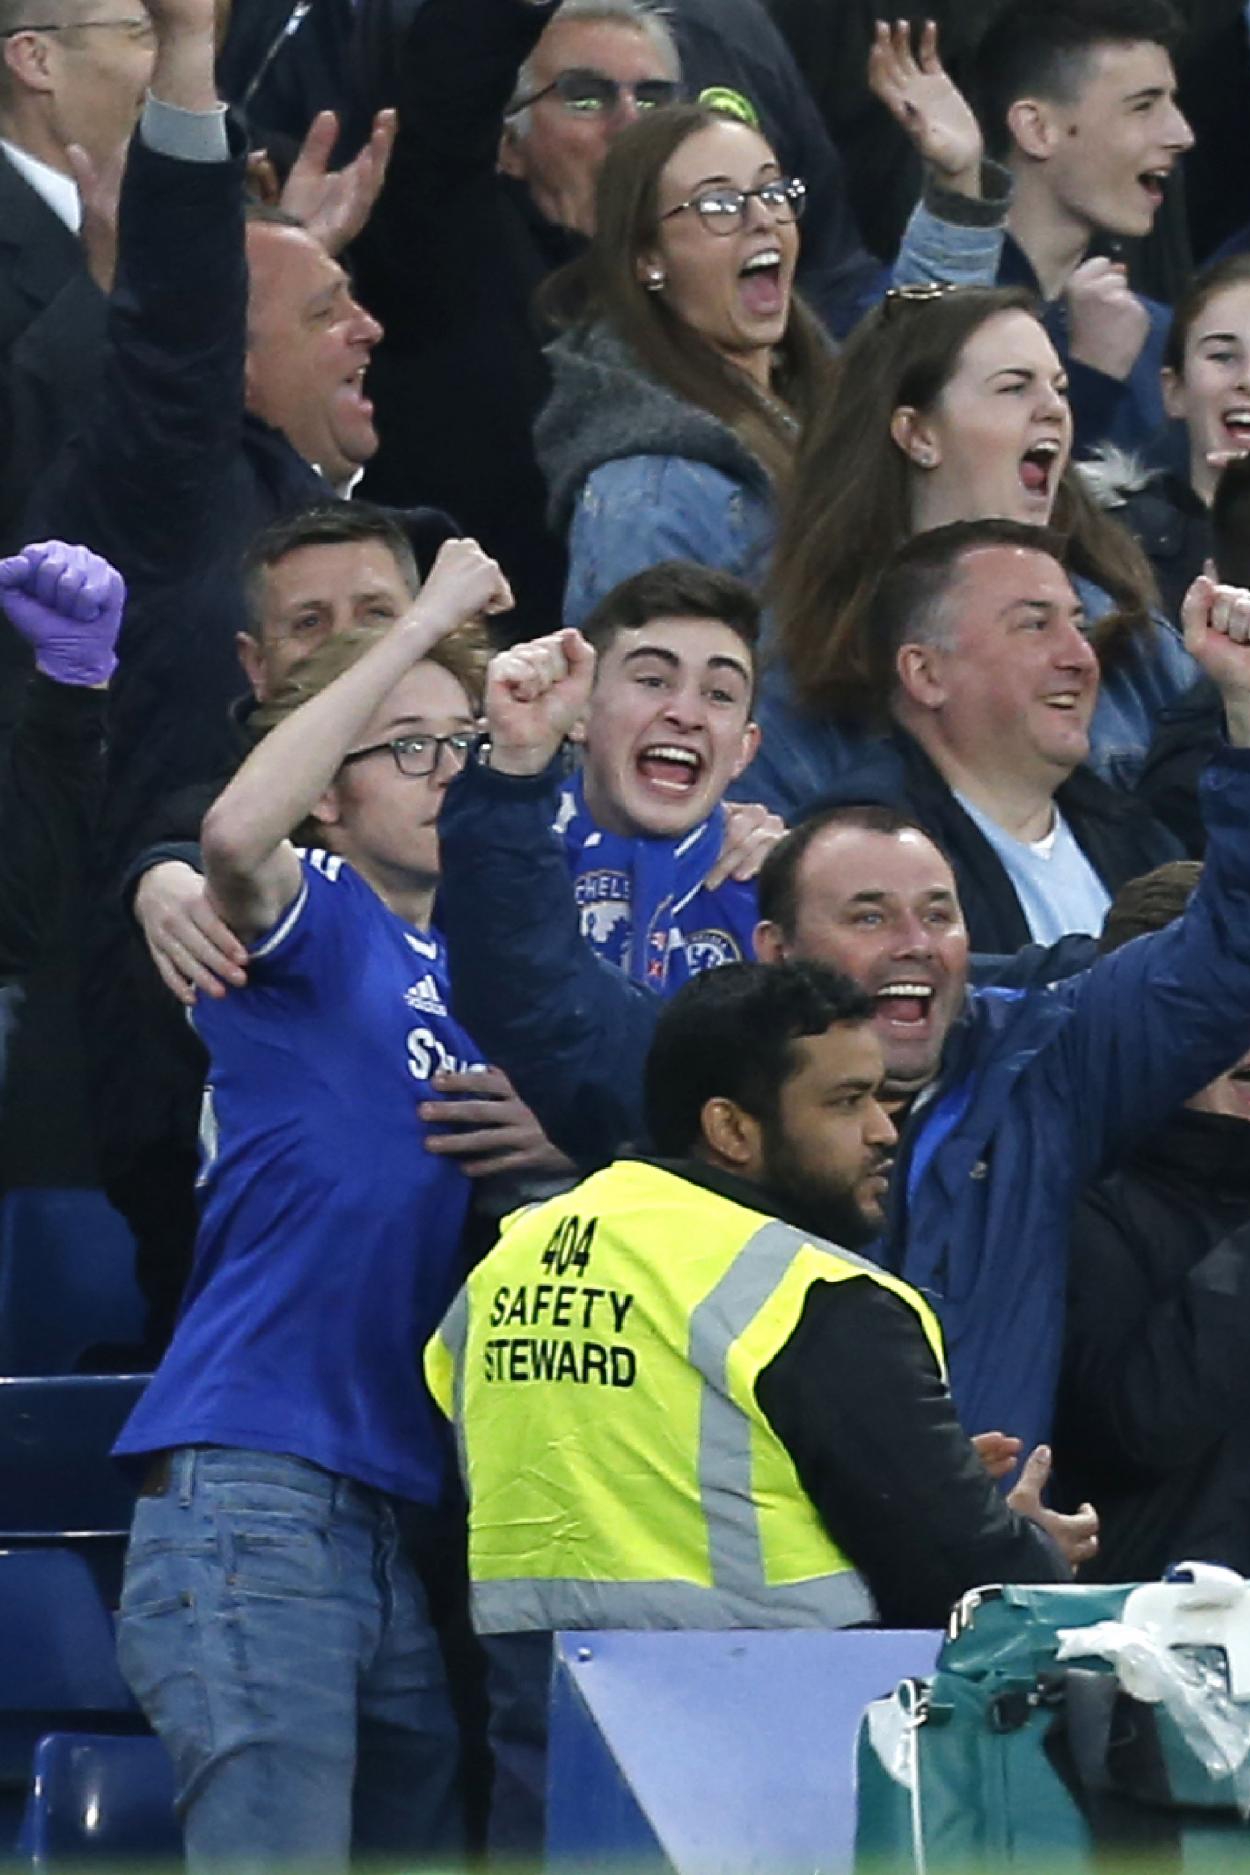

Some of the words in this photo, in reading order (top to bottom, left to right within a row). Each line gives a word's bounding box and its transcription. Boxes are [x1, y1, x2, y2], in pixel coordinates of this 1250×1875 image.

[541, 1215, 598, 1277] 404
[490, 1284, 633, 1333] SAFETY
[485, 1338, 636, 1388] STEWARD
